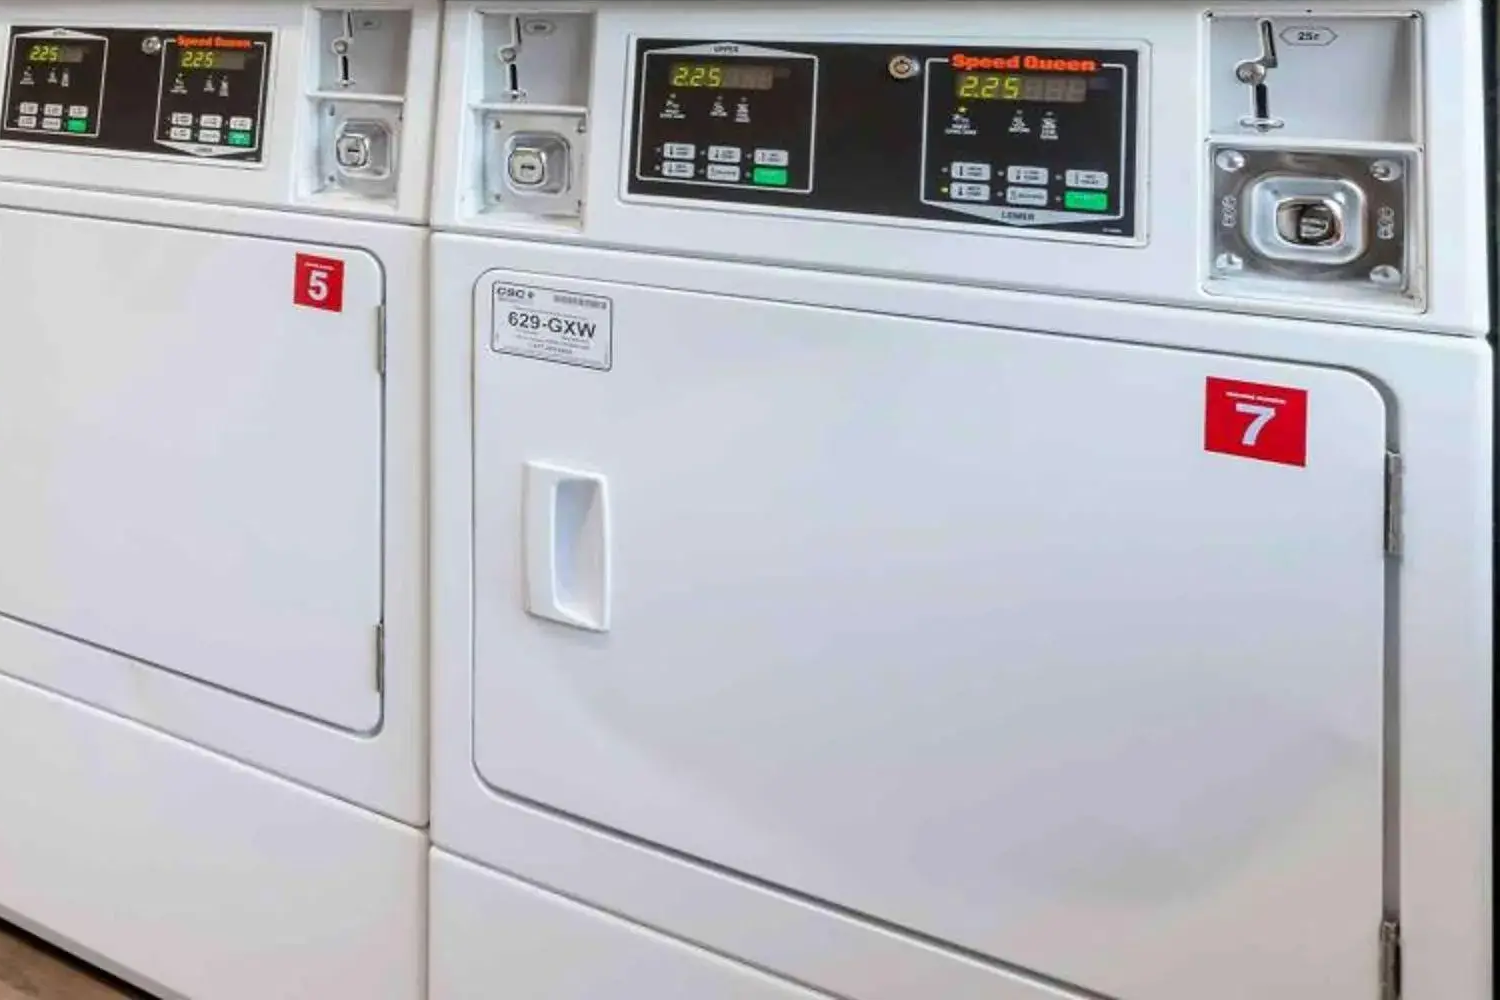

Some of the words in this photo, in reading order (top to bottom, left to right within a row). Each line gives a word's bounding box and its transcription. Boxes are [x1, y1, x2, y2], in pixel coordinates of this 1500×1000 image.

[951, 53, 1020, 70] Speed
[1023, 55, 1097, 72] Queen
[308, 269, 329, 301] 5
[507, 311, 597, 339] 629-GXW
[1235, 402, 1276, 446] 7
